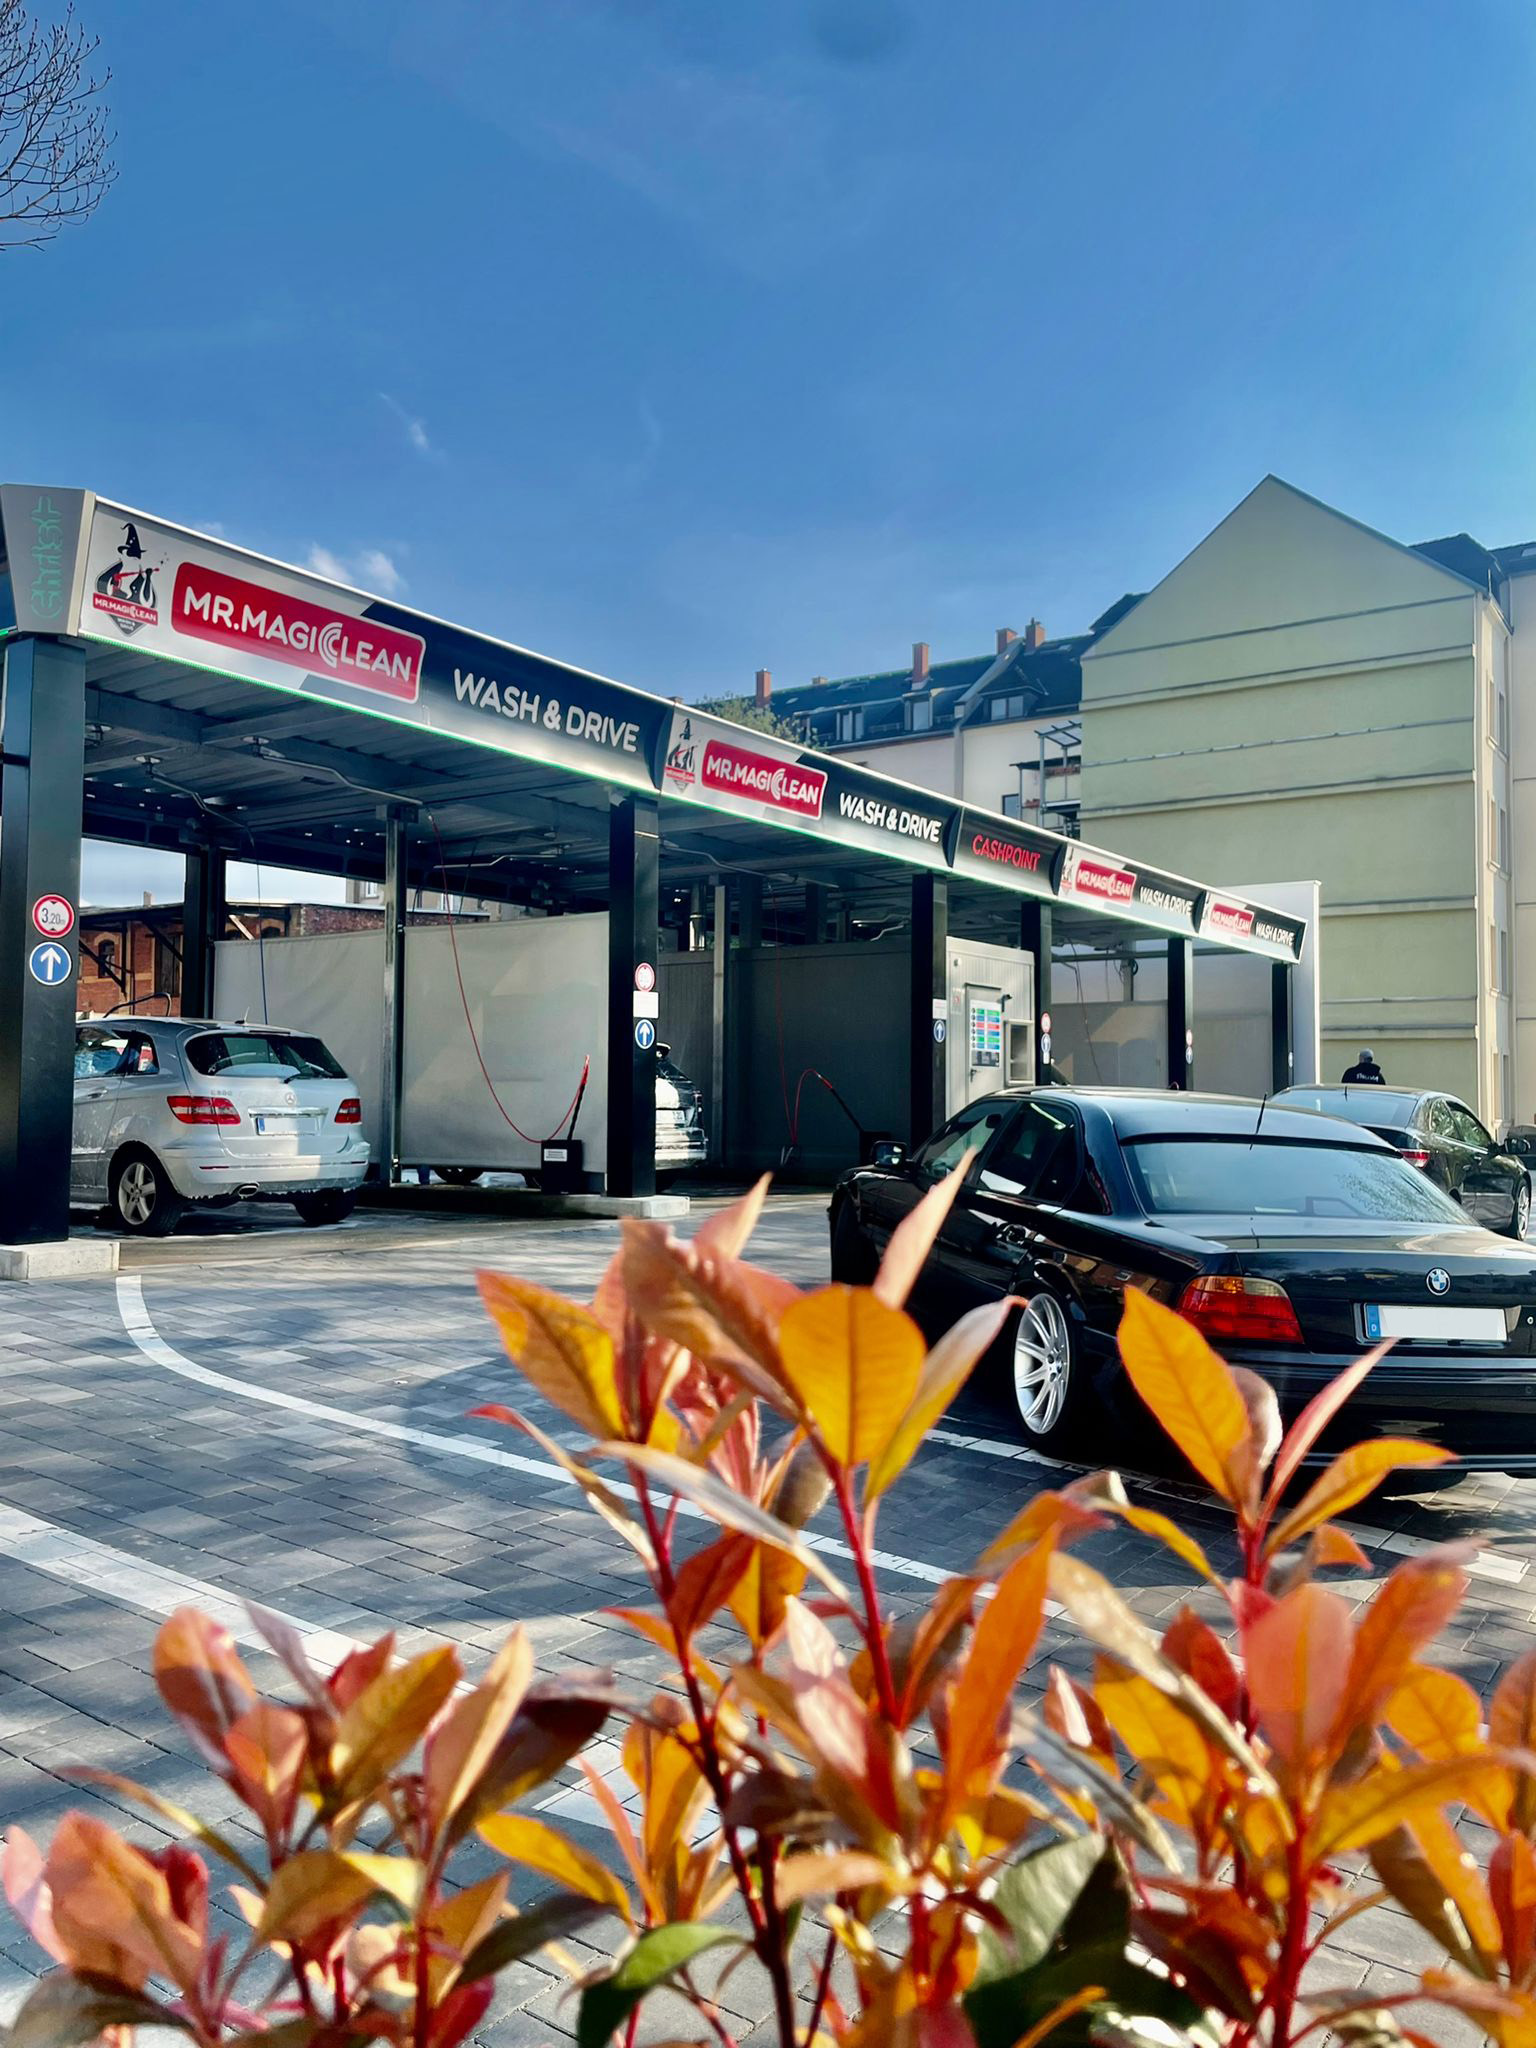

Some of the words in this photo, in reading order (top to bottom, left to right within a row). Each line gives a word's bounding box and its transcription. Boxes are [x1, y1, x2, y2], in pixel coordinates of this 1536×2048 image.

[454, 668, 540, 724] WASH
[543, 699, 562, 731] &
[565, 705, 640, 753] DRIVE
[839, 792, 885, 827] WASH
[886, 808, 898, 831] &
[899, 811, 942, 843] DRIVE
[972, 834, 1041, 872] CASHPOINT
[1140, 886, 1164, 909] WASH
[1169, 895, 1193, 916] DRIVE
